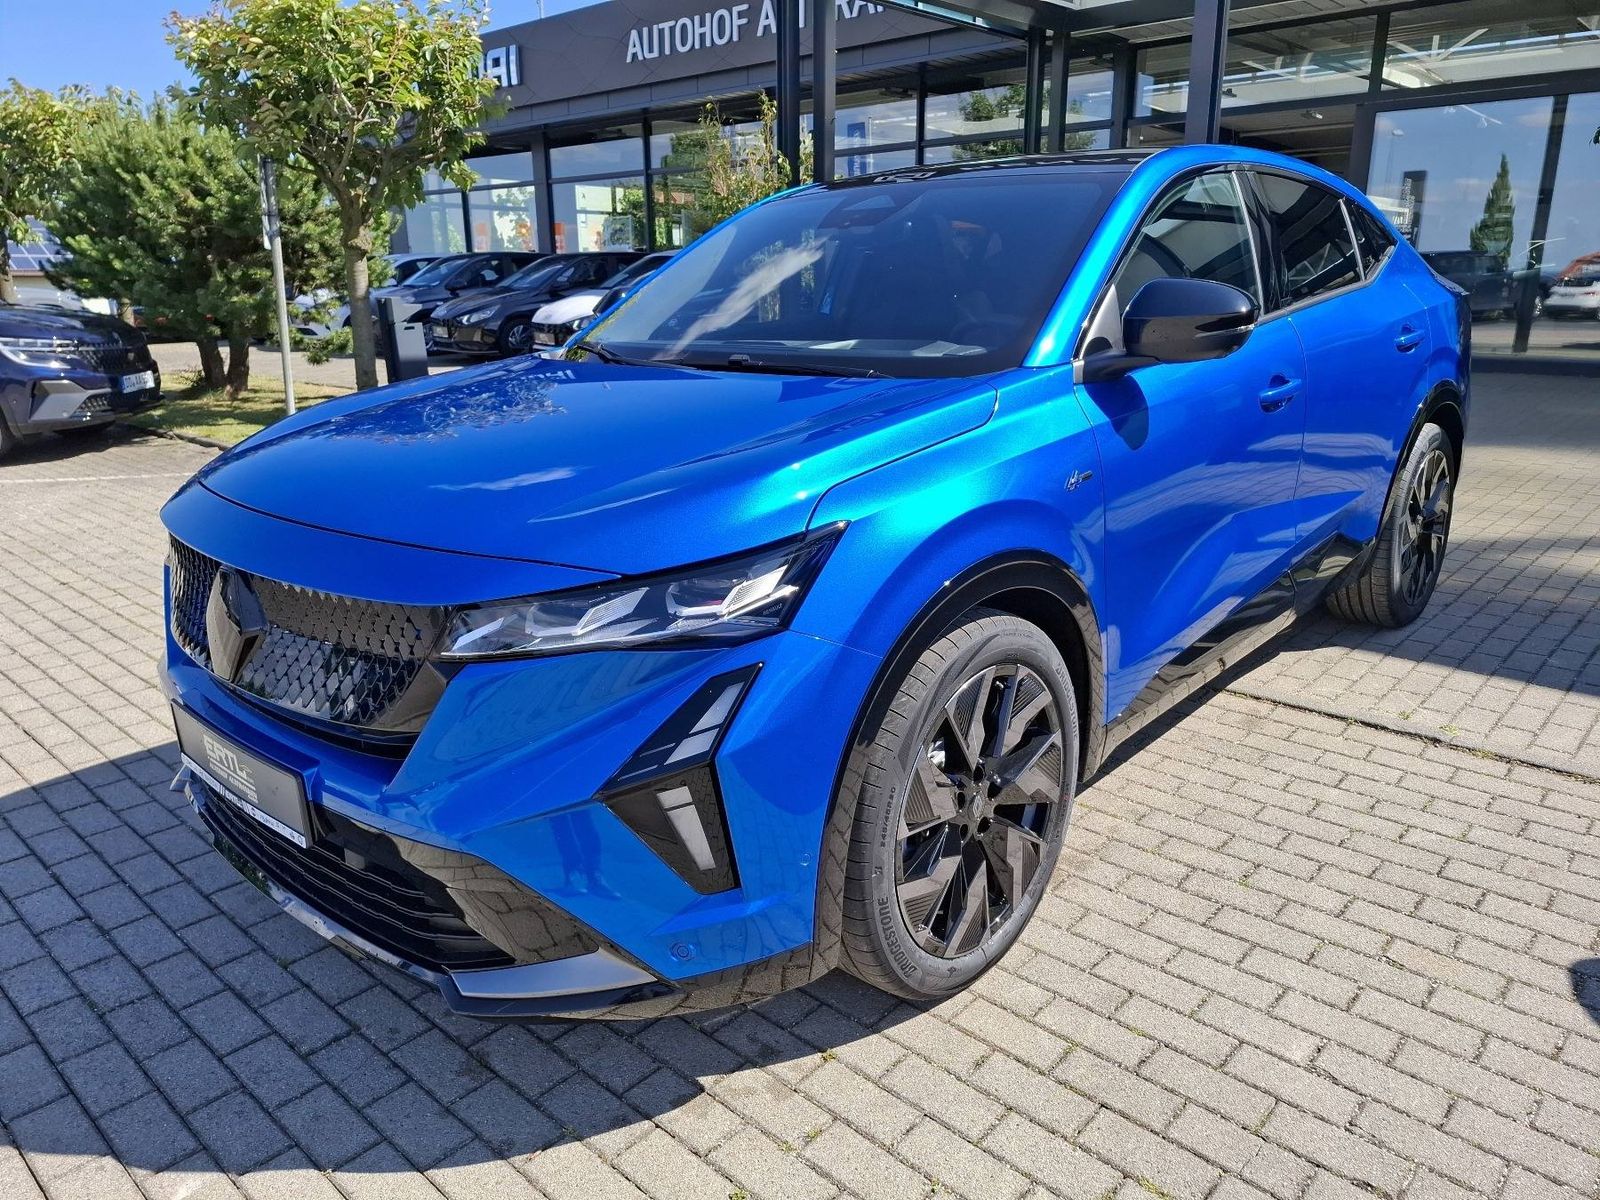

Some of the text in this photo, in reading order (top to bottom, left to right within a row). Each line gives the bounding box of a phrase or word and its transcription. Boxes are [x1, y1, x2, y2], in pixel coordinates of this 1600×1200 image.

[626, 3, 749, 62] AUTOHOF
[203, 734, 248, 779] ERTL
[878, 896, 918, 980] BRIDGESTONE
